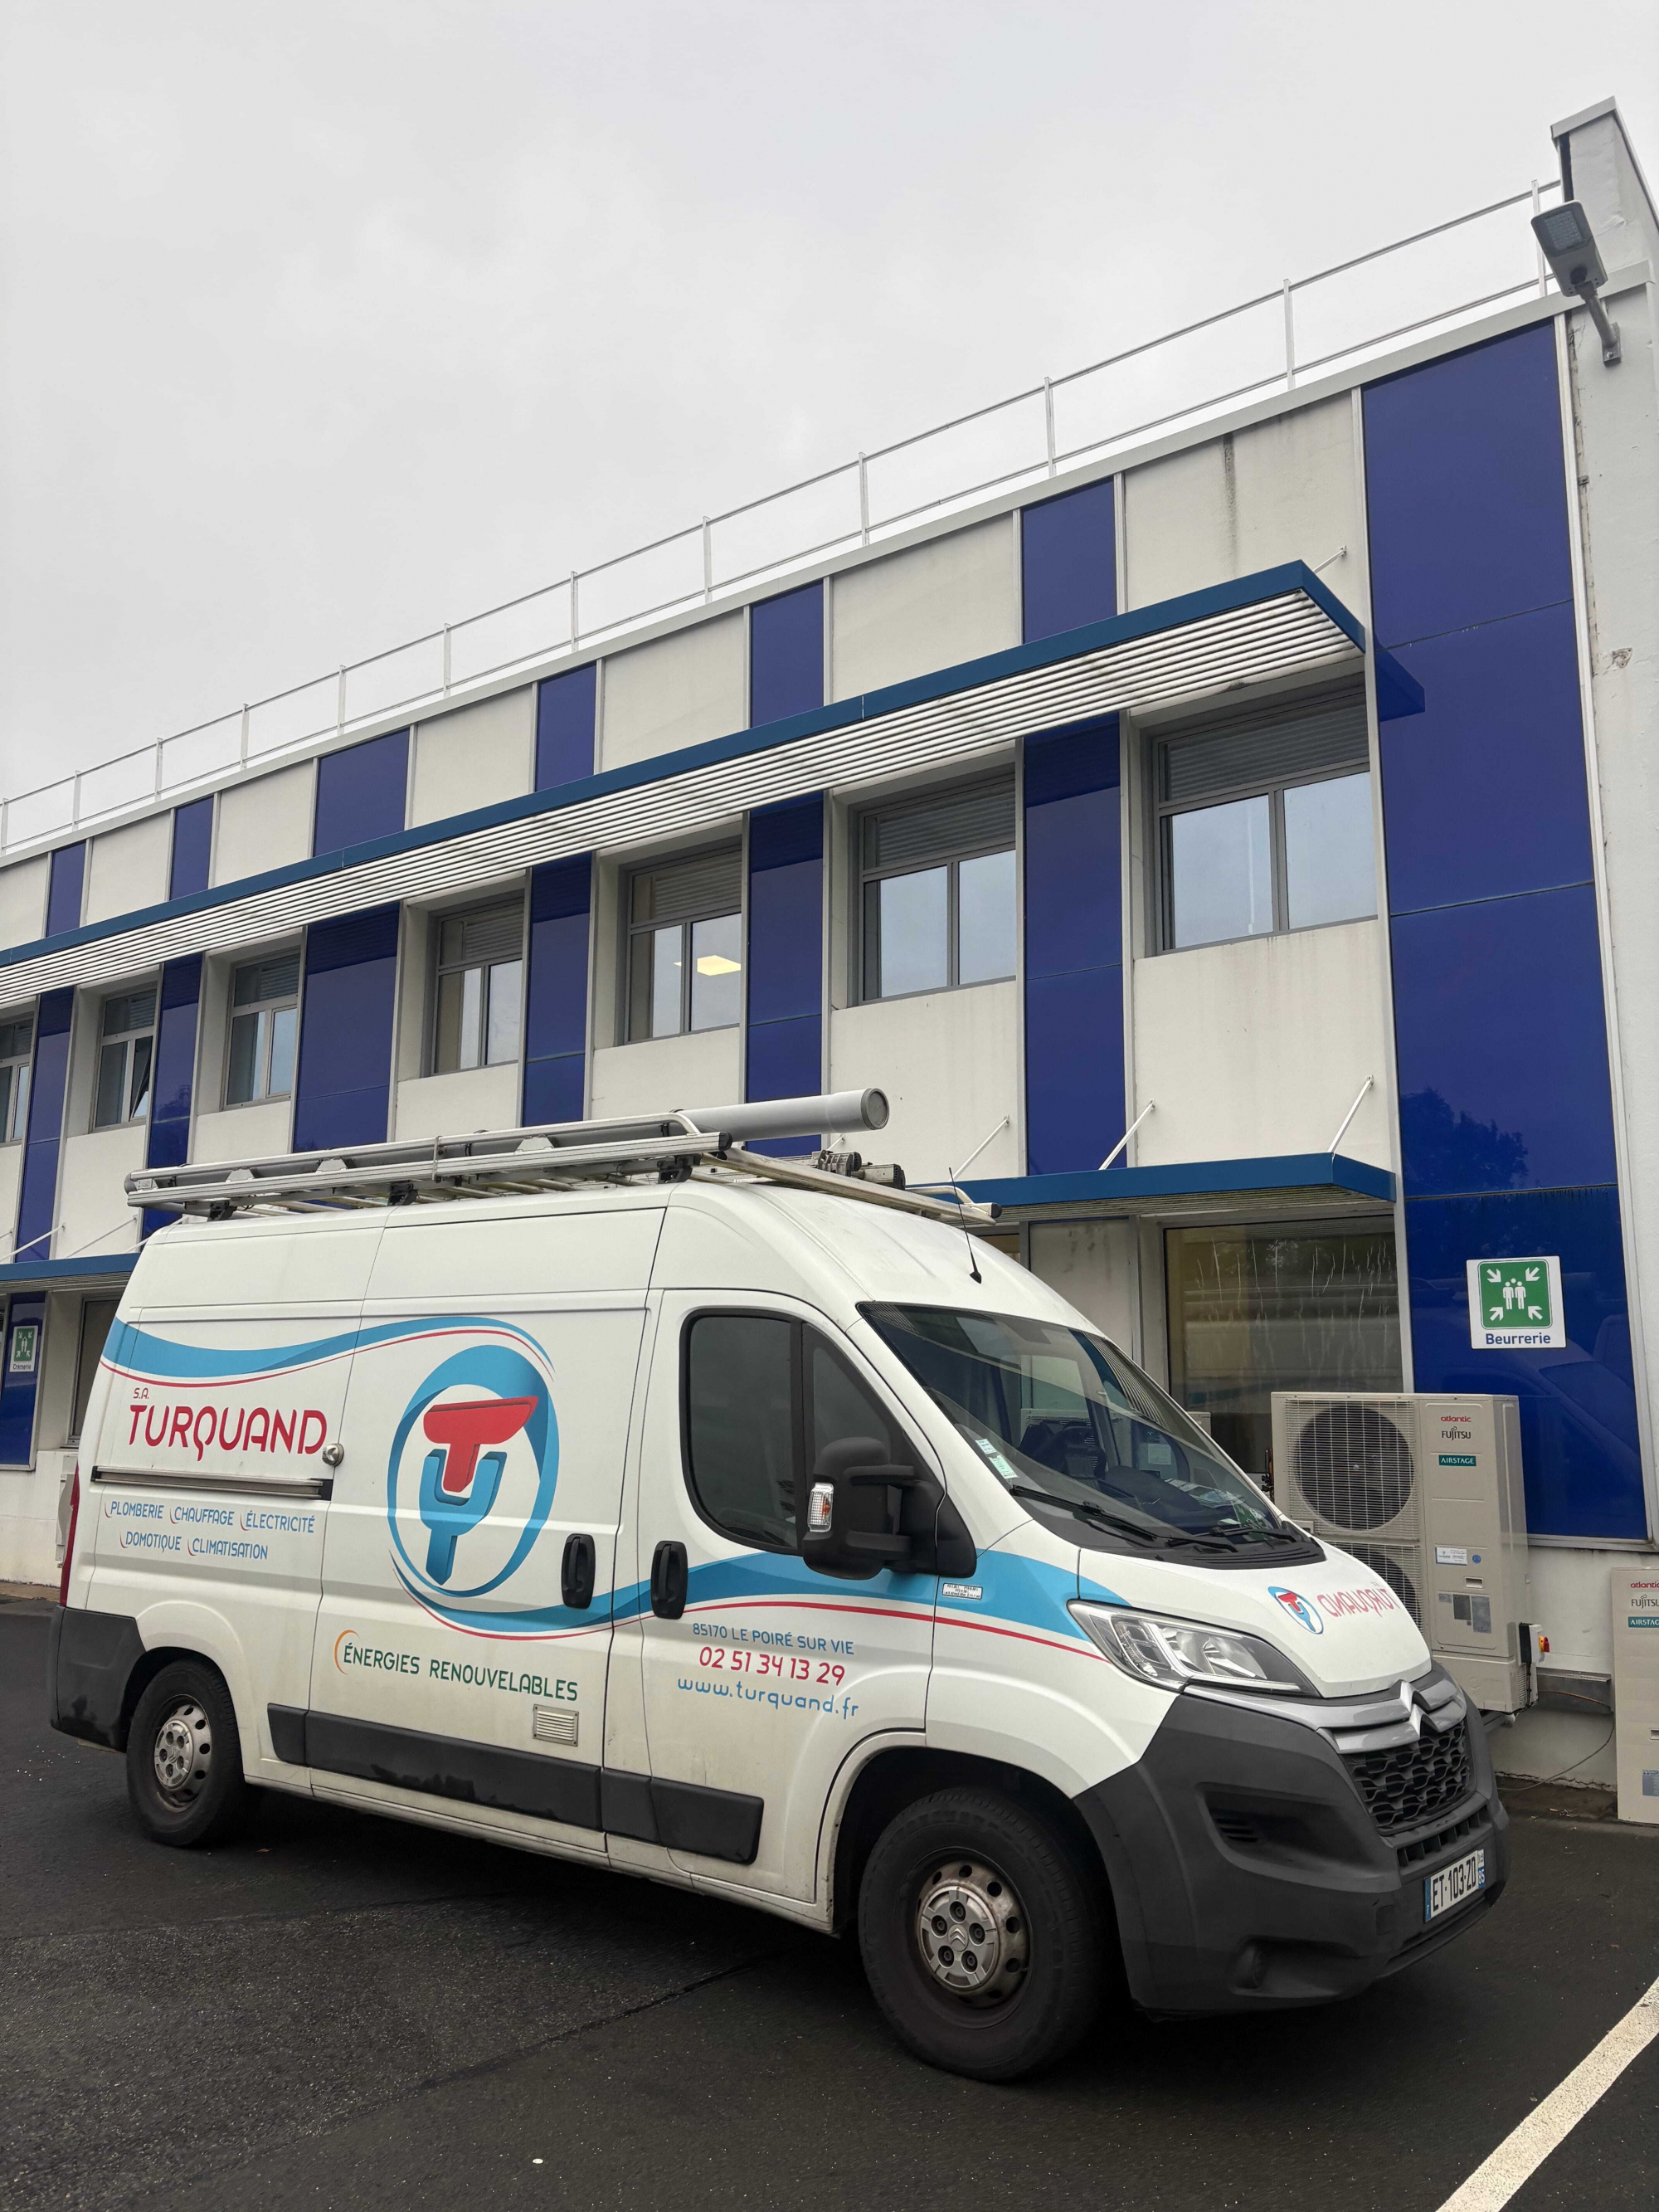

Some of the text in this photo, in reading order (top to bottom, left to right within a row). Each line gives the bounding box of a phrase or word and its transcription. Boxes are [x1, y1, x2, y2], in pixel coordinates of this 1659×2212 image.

[1486, 1332, 1551, 1345] Beurrerie
[133, 1387, 150, 1400] S.A.
[129, 1404, 328, 1462] TURQUAND
[1441, 1426, 1472, 1440] FUJITSU
[109, 1501, 316, 1533] PLOMBERIE CHAUFFAGE ÉLECTRICITÉ
[125, 1531, 269, 1560] DOMOTIQUE CLIMATISATION
[693, 1623, 854, 1655] 85170 LE POIRÉ SUR VIE
[343, 1643, 578, 1702] ÉNERGIES RENOUVELABLES
[698, 1646, 845, 1686] 02 51 34 13 29
[677, 1678, 859, 1720] www.turquand.fr
